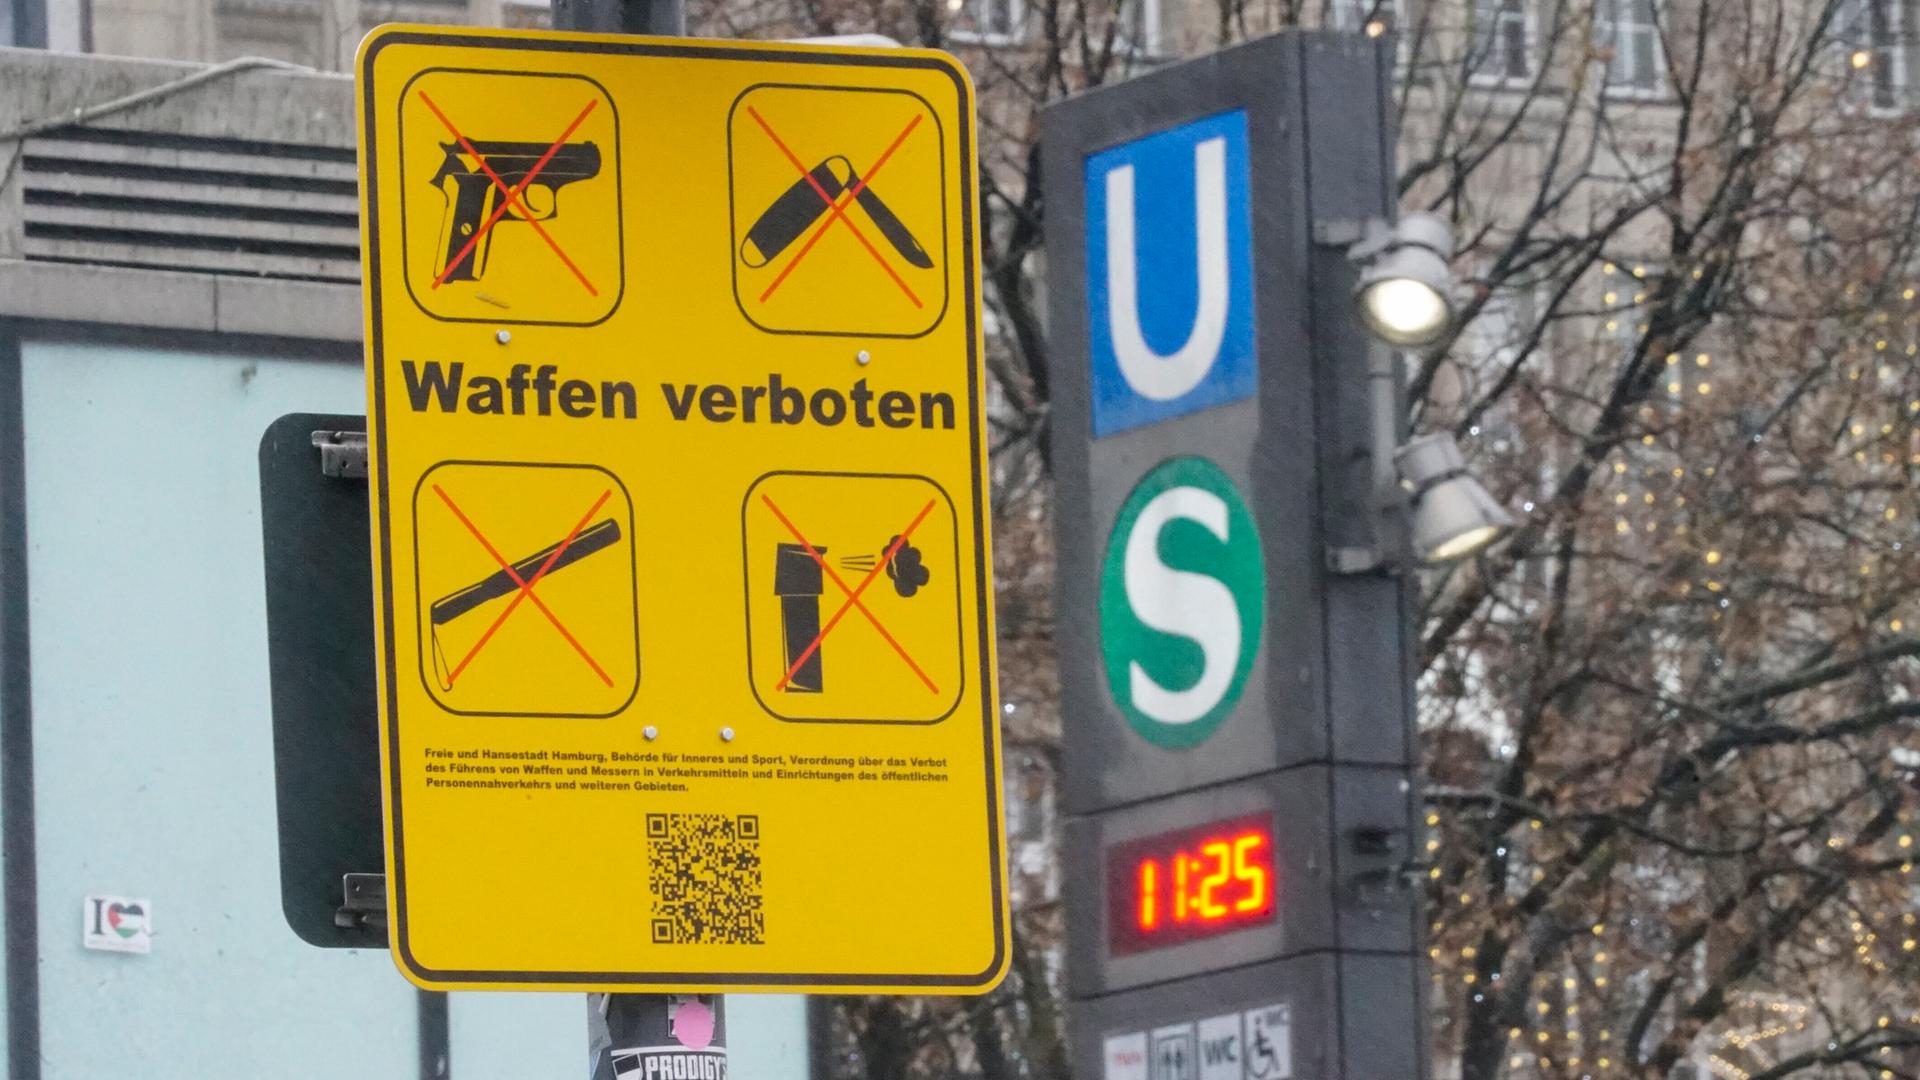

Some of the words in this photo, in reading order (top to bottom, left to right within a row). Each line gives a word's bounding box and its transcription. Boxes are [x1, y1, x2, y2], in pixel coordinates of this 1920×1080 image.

[1106, 137, 1228, 400] U
[401, 360, 637, 419] Waffen
[661, 373, 956, 430] verboten
[1124, 486, 1242, 725] S
[425, 748, 454, 758] Freie
[458, 750, 478, 758] und
[483, 750, 548, 760] Hansestadt
[552, 751, 608, 763] Hamburg,
[611, 752, 659, 762] Behörde
[662, 753, 678, 762] für
[682, 754, 724, 763] Inneres
[728, 754, 748, 763] und
[752, 754, 787, 766] Sport,
[790, 755, 855, 767] Verordnung
[858, 757, 883, 766] über
[886, 757, 906, 766] das
[910, 758, 947, 767] Verbot
[425, 763, 446, 772] des
[450, 763, 496, 773] Führens
[523, 765, 563, 775] Waffen
[567, 766, 587, 775] und
[591, 766, 640, 776] Messern
[644, 767, 654, 776] in
[657, 768, 749, 778] Verkehrsmitteln
[753, 769, 772, 778] und
[777, 769, 854, 782] Einrichtungen
[858, 771, 877, 780] des
[882, 772, 948, 781] öffentlichen
[426, 778, 551, 789] Personennahverkehrs
[555, 780, 576, 789] und
[580, 781, 630, 791] weiteren
[634, 781, 689, 791] Gebieten.
[1142, 835, 1264, 926] 11:25
